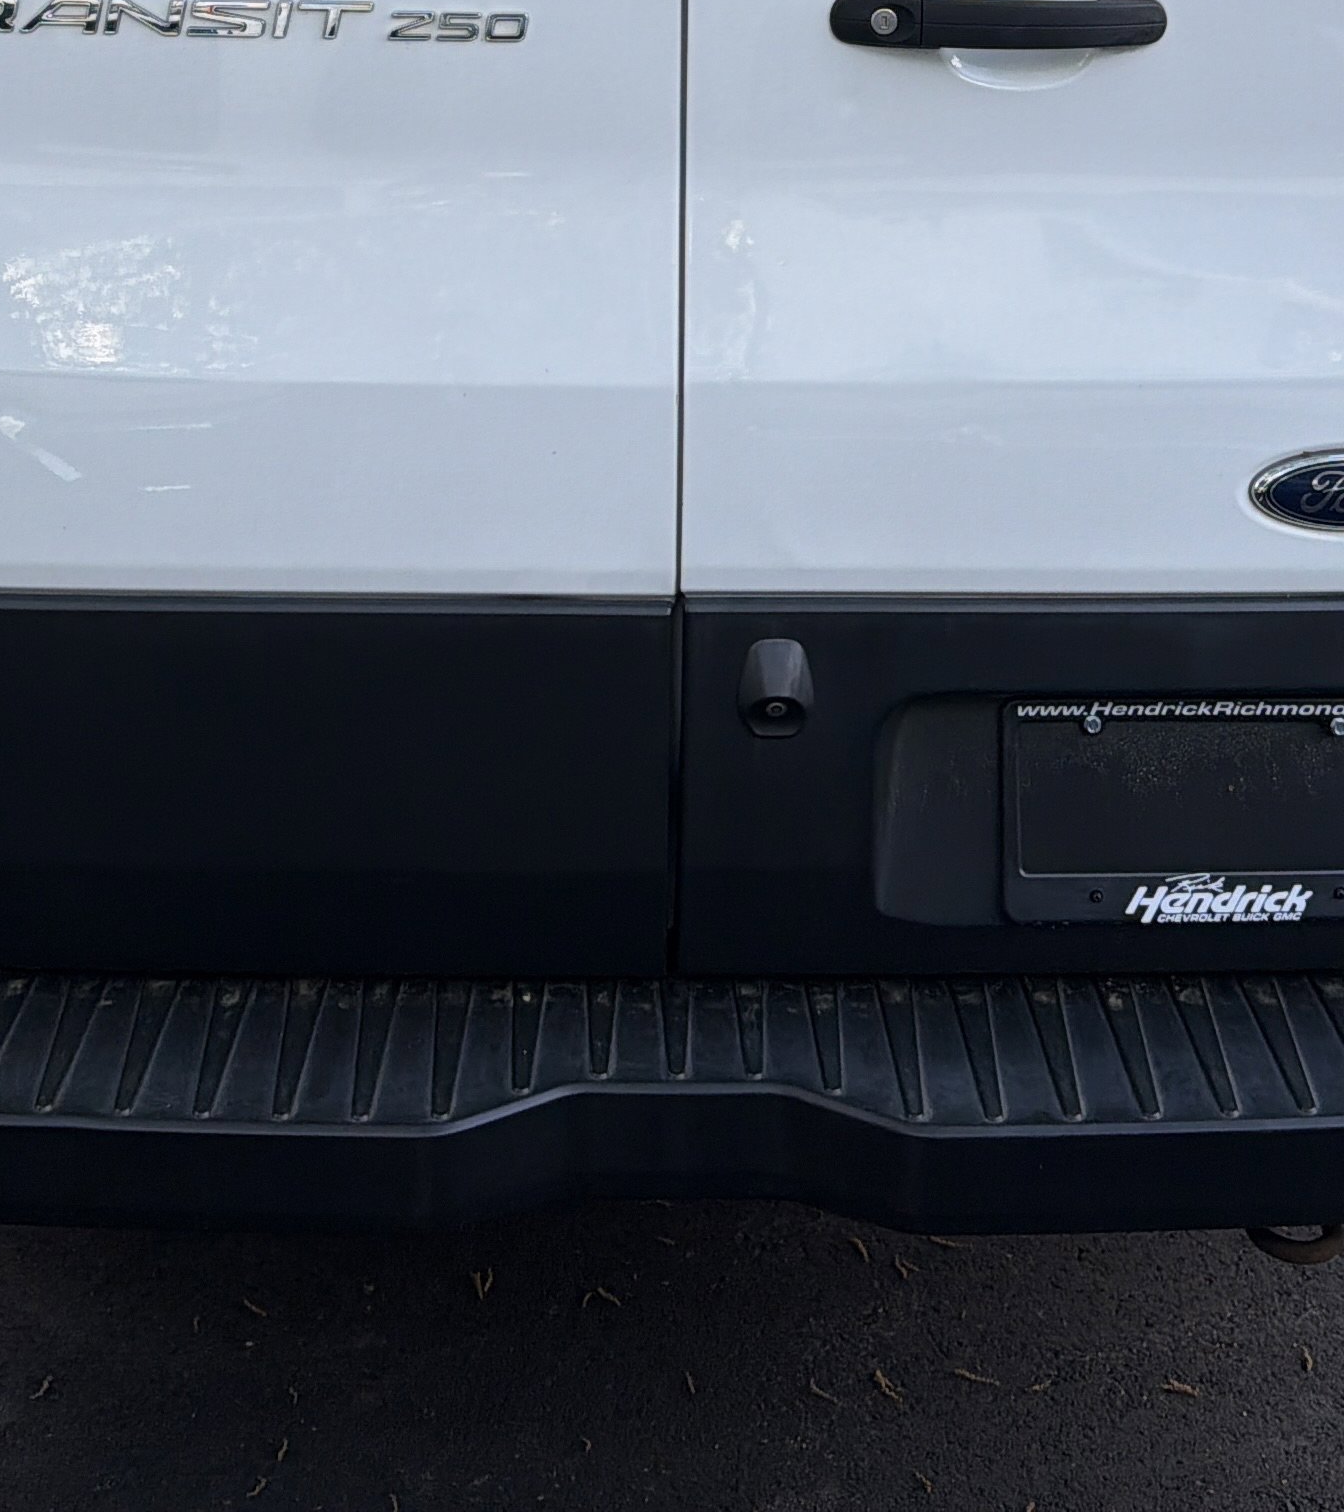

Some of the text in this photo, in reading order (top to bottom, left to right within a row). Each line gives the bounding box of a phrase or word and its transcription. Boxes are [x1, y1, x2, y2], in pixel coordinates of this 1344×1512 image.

[388, 9, 528, 42] 250
[1125, 884, 1313, 923] Hendrick
[1157, 912, 1303, 923] CHEVROLET BUICK GMC
